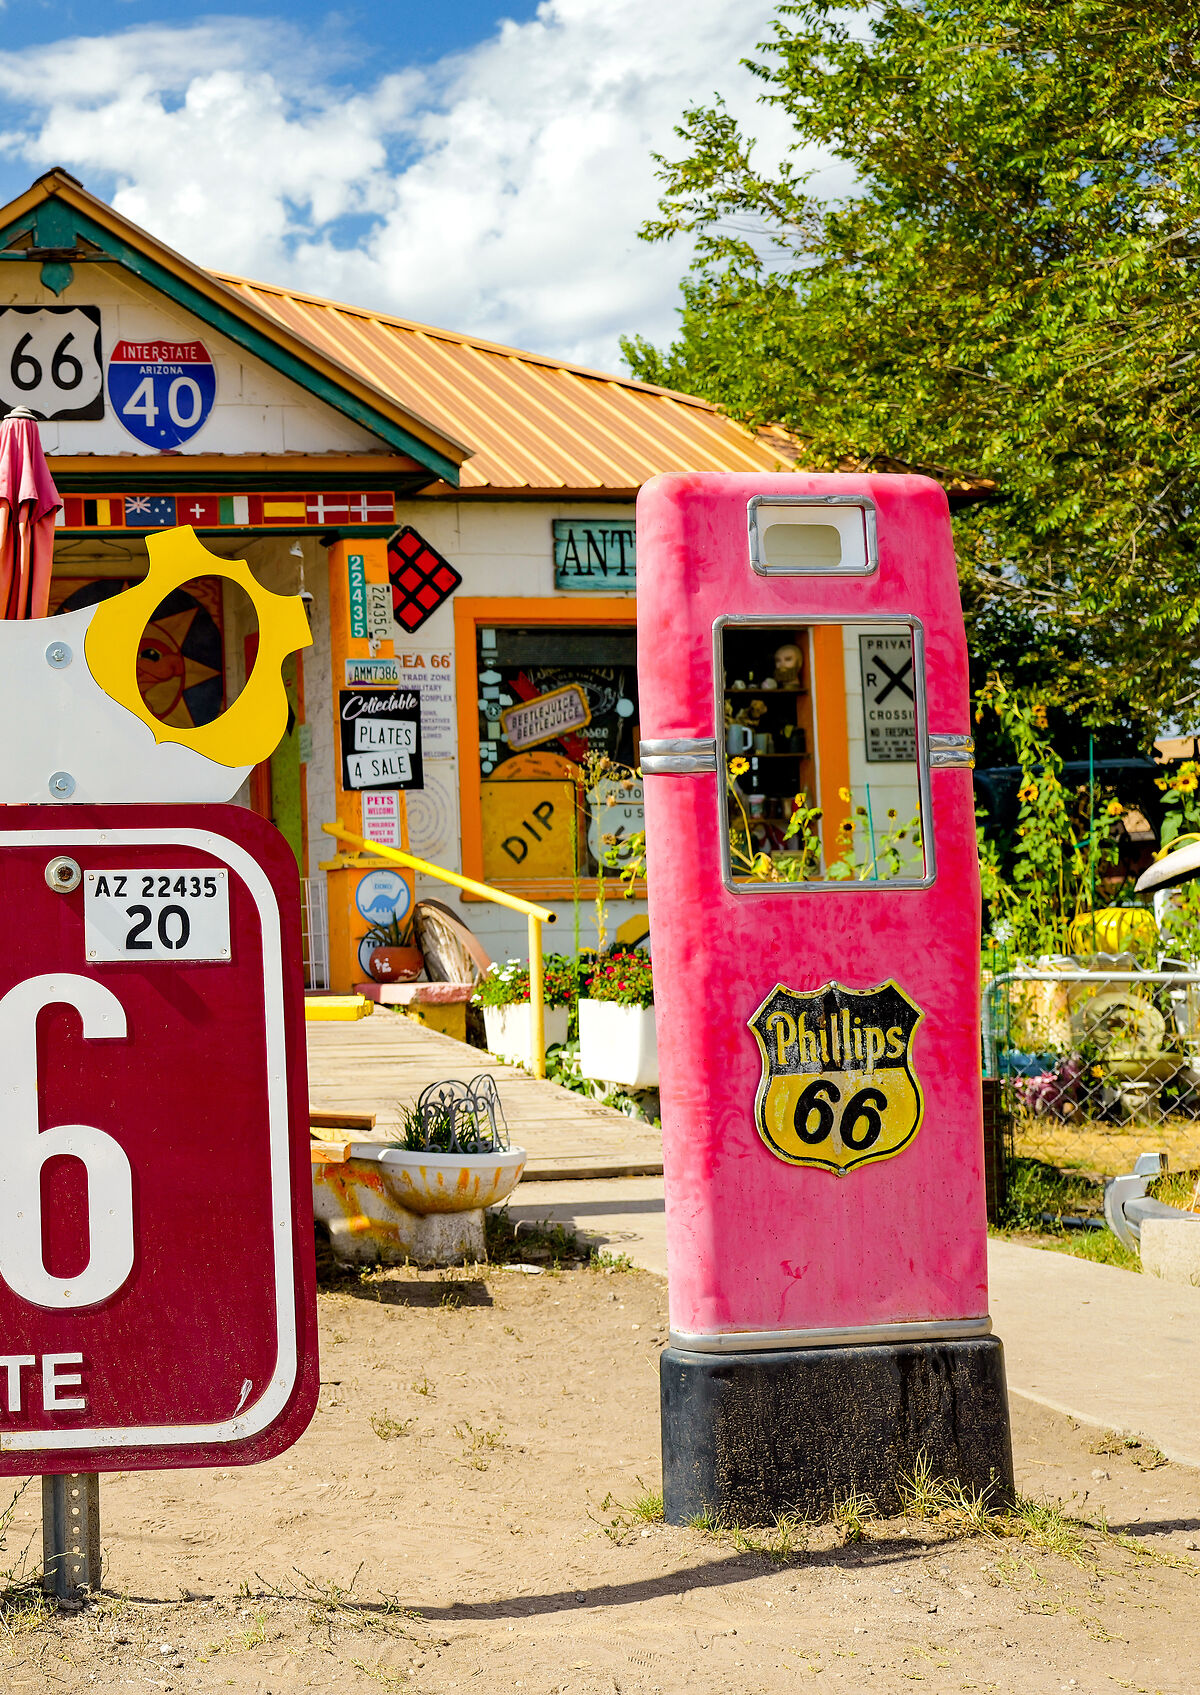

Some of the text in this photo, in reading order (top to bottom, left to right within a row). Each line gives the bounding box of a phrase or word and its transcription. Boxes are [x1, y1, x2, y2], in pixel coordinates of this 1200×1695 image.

[11, 332, 83, 391] 66
[123, 346, 198, 360] INTERSTATE
[139, 366, 184, 375] ARIZONA
[123, 376, 202, 428] 40
[560, 529, 636, 577] ANT
[351, 556, 364, 637] 22435
[354, 666, 398, 681] AMM7386
[430, 655, 451, 669] 66
[342, 693, 418, 720] Collectable
[512, 695, 575, 729] BEETLEJUICE
[869, 710, 915, 720] CROSSI
[360, 726, 412, 746] PLATES
[517, 705, 580, 740] BEETLEJUICE
[355, 756, 407, 778] 4 SALE
[367, 796, 394, 805] PETS
[368, 807, 394, 815] WELCOME
[501, 801, 554, 864] DIP
[95, 876, 217, 898] AZ 22435
[125, 904, 190, 950] 20
[766, 1008, 905, 1075] Phillips
[794, 1079, 888, 1151] 66
